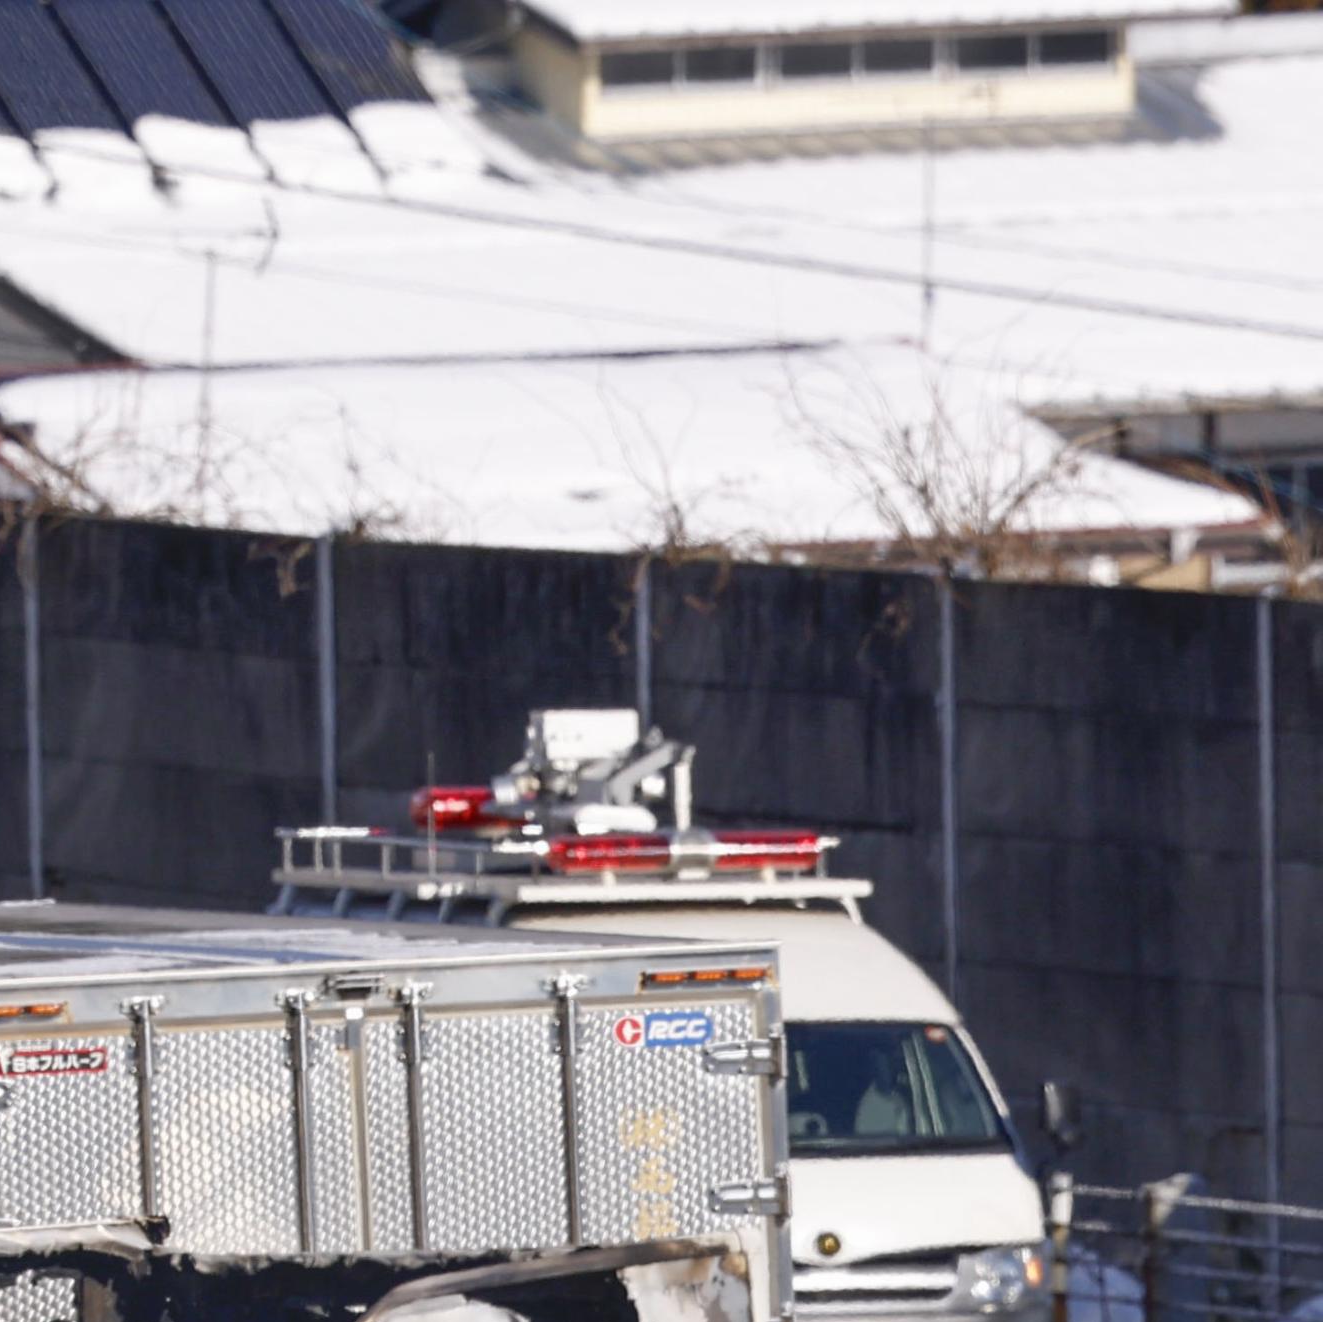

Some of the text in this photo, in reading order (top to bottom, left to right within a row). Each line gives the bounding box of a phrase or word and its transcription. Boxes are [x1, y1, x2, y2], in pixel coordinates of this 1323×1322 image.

[12, 1051, 105, 1073] 日本フルハーフ
